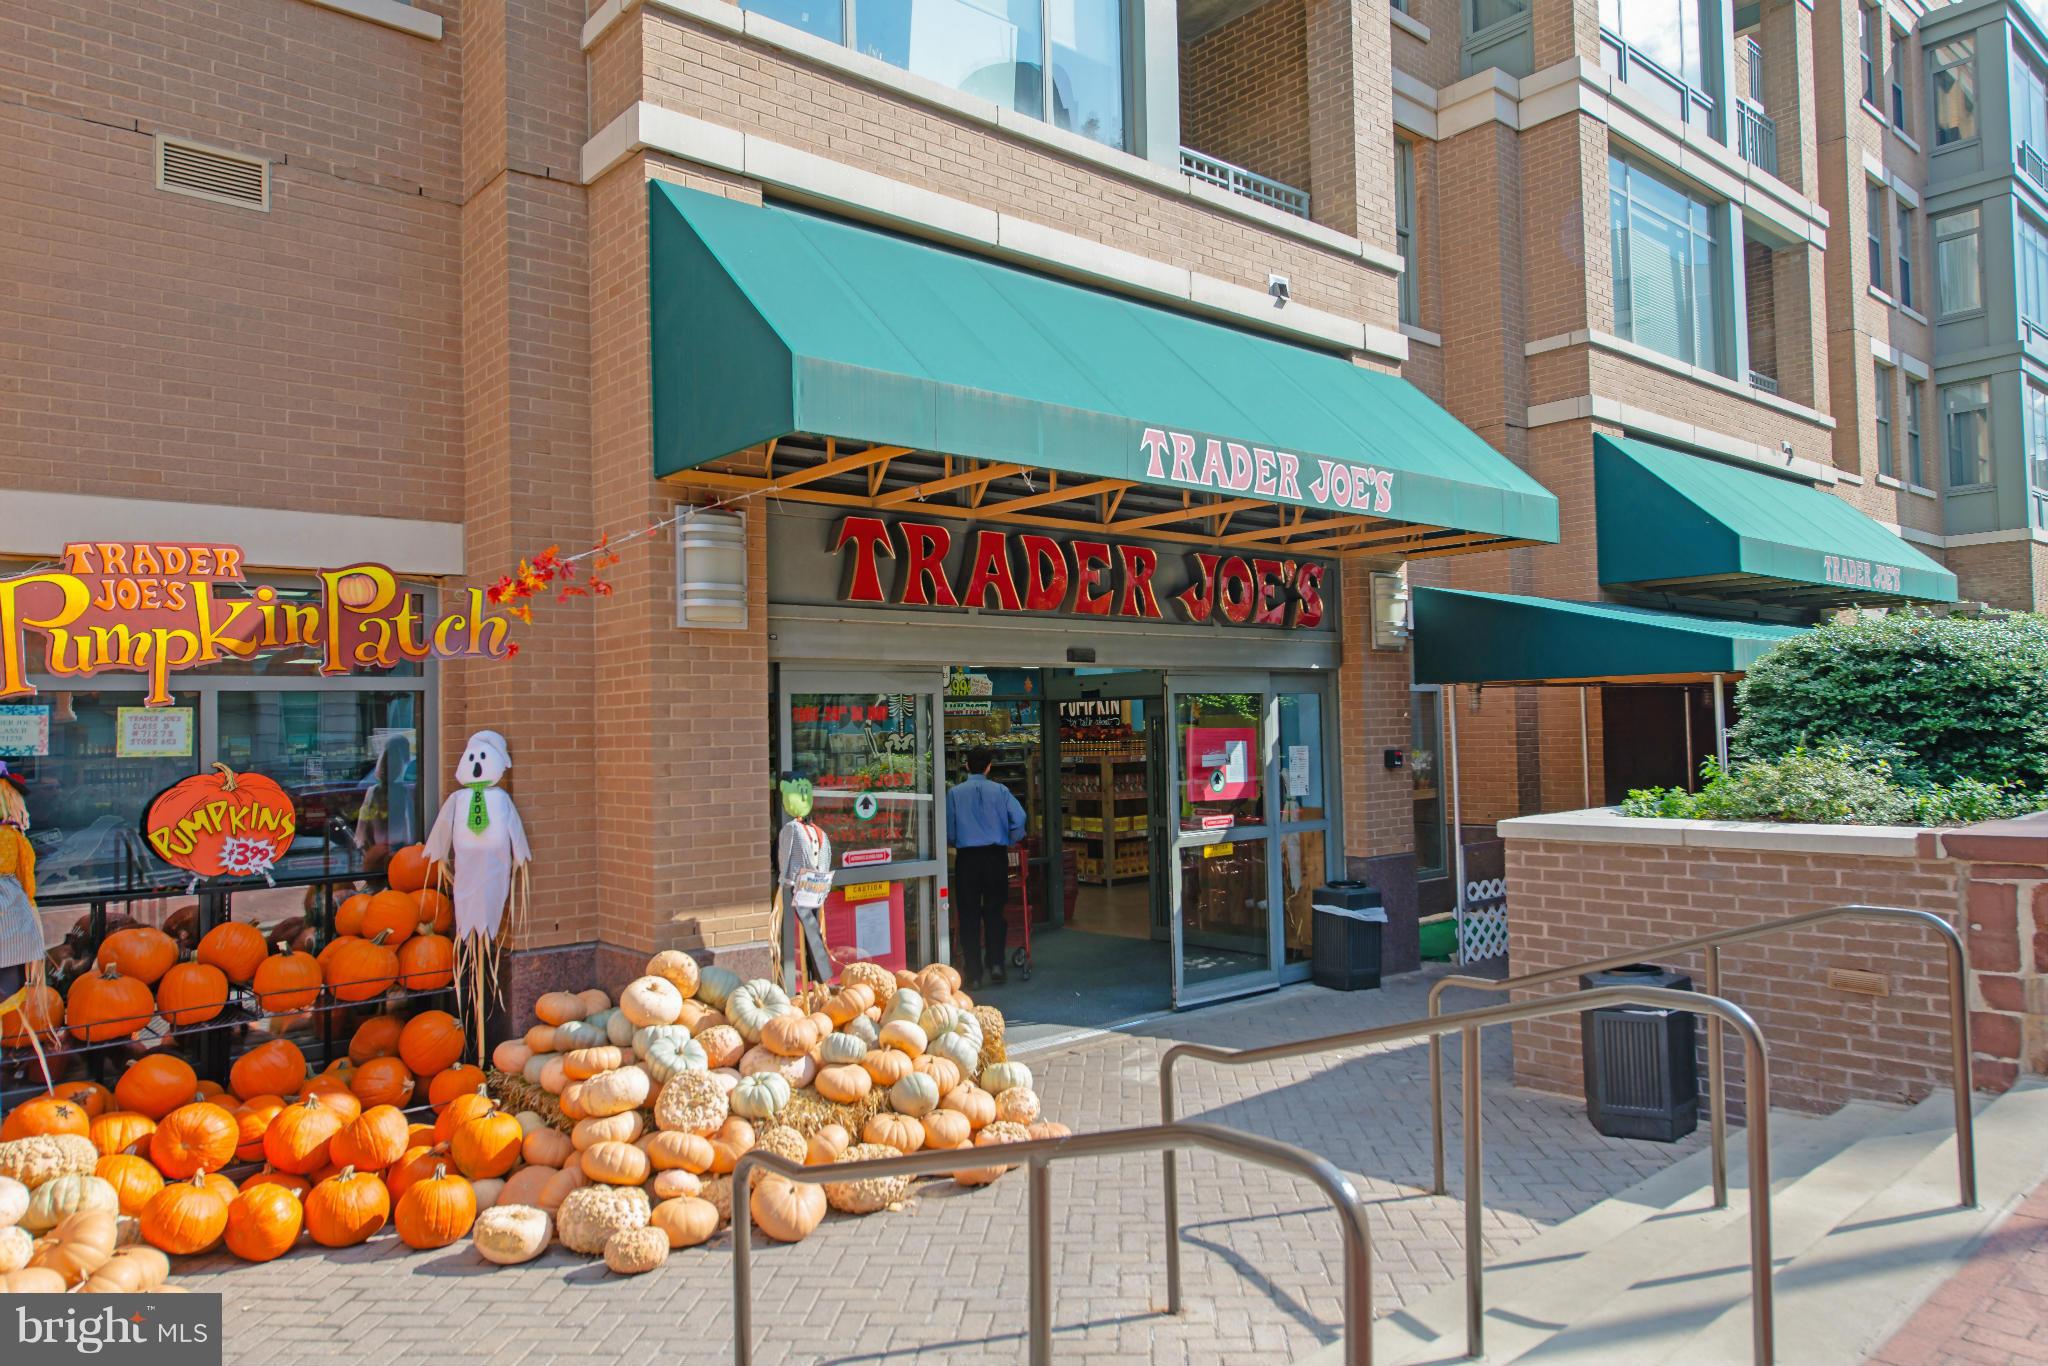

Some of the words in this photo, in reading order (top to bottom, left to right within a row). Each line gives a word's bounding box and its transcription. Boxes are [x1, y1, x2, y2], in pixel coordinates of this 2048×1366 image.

[1140, 428, 1302, 500] TRADER
[1309, 460, 1393, 513] JOE'S
[65, 543, 240, 577] TRADER
[832, 516, 1163, 619] TRADER
[1176, 551, 1325, 629] JOE'S
[1824, 555, 1872, 587] TRADER
[1873, 564, 1900, 592] JOE'S
[93, 578, 187, 611] JOE'S
[0, 573, 321, 703] Pumpkin
[321, 566, 511, 672] Patch
[1060, 700, 1120, 716] PUMPKIN
[148, 800, 296, 860] PUMPKINS
[852, 884, 883, 893] CAUTION
